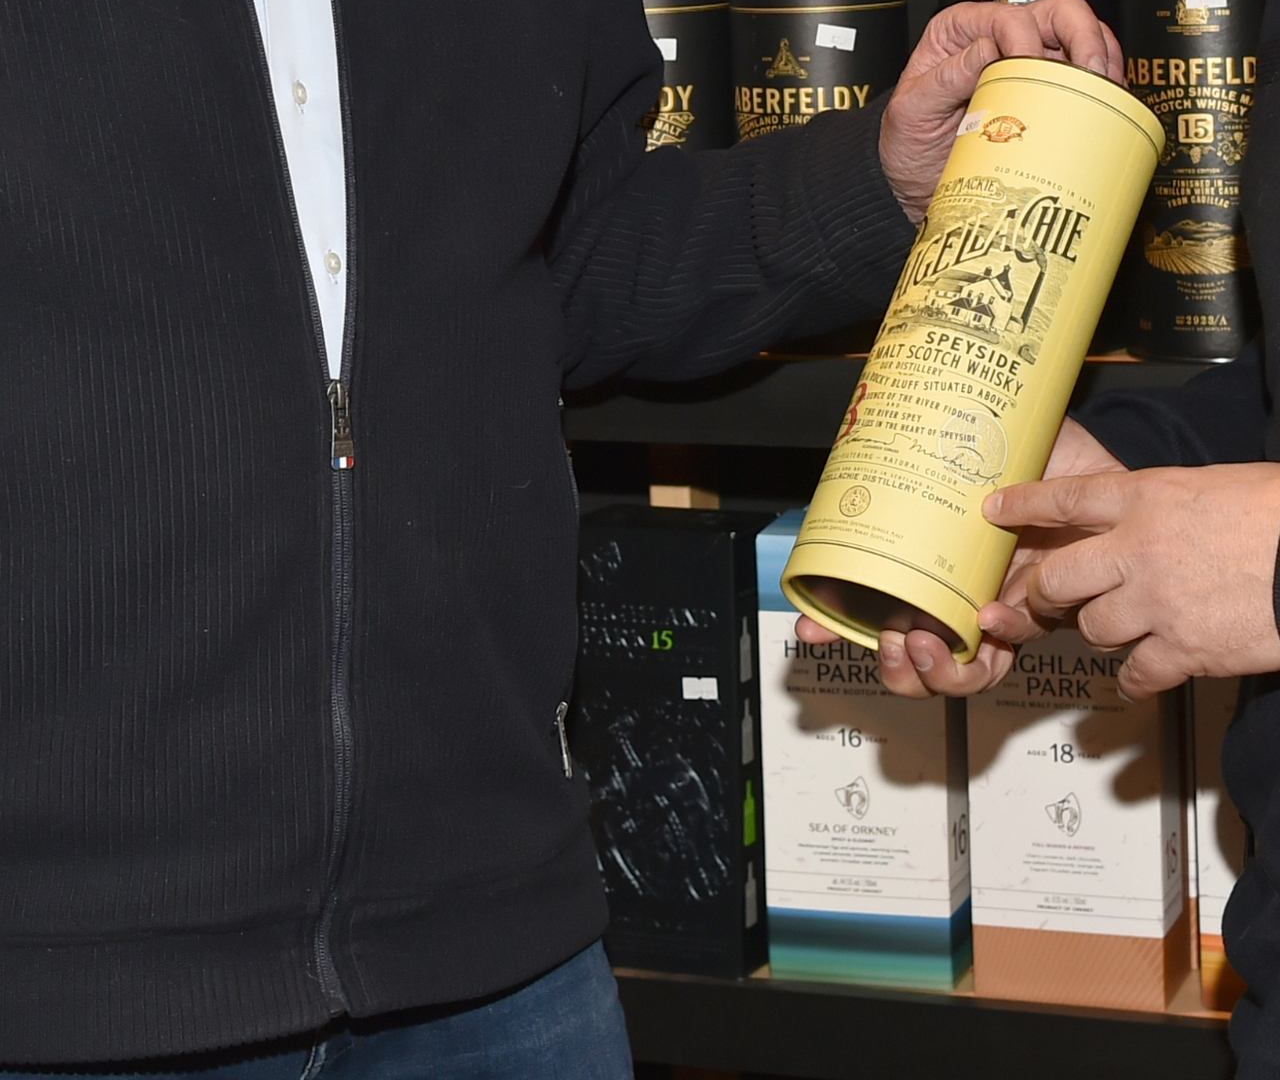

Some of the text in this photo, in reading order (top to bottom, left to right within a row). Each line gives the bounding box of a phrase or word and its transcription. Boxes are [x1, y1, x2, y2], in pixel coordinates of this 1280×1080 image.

[1127, 56, 1259, 86] ABERFELD
[735, 84, 871, 113] ABERFELDY
[1188, 86, 1238, 102] SINGLE
[1195, 98, 1248, 117] WHISKY
[1181, 118, 1209, 140] 15
[954, 176, 999, 199] MACKIE
[994, 166, 1076, 196] OLD FASHIONED IN
[1172, 179, 1210, 188] FINISHED
[1194, 186, 1216, 196] WINE
[1190, 195, 1231, 209] CADILLAC
[924, 330, 1022, 377] SPEYSIDE
[876, 344, 1025, 397] MALT SCOTCH WHISKY
[895, 361, 944, 378] DISTILLERY
[891, 377, 1009, 412] BLUFF SITUATED ABOVE
[876, 408, 923, 423] RIVER SPEY
[898, 393, 977, 425] THE RIVER FIDDICH
[886, 421, 977, 443] THE HEART OF SPEYSIDE
[883, 456, 959, 487] NATURAL COLOUR
[862, 474, 968, 517] DISTILLERY COMPANY
[651, 630, 674, 650] 15
[817, 663, 880, 684] PARK
[1026, 677, 1092, 699] PARK
[837, 728, 863, 748] 16
[1049, 743, 1074, 764] 18
[809, 821, 898, 837] SEA OF ORKNEY
[950, 814, 968, 862] 16
